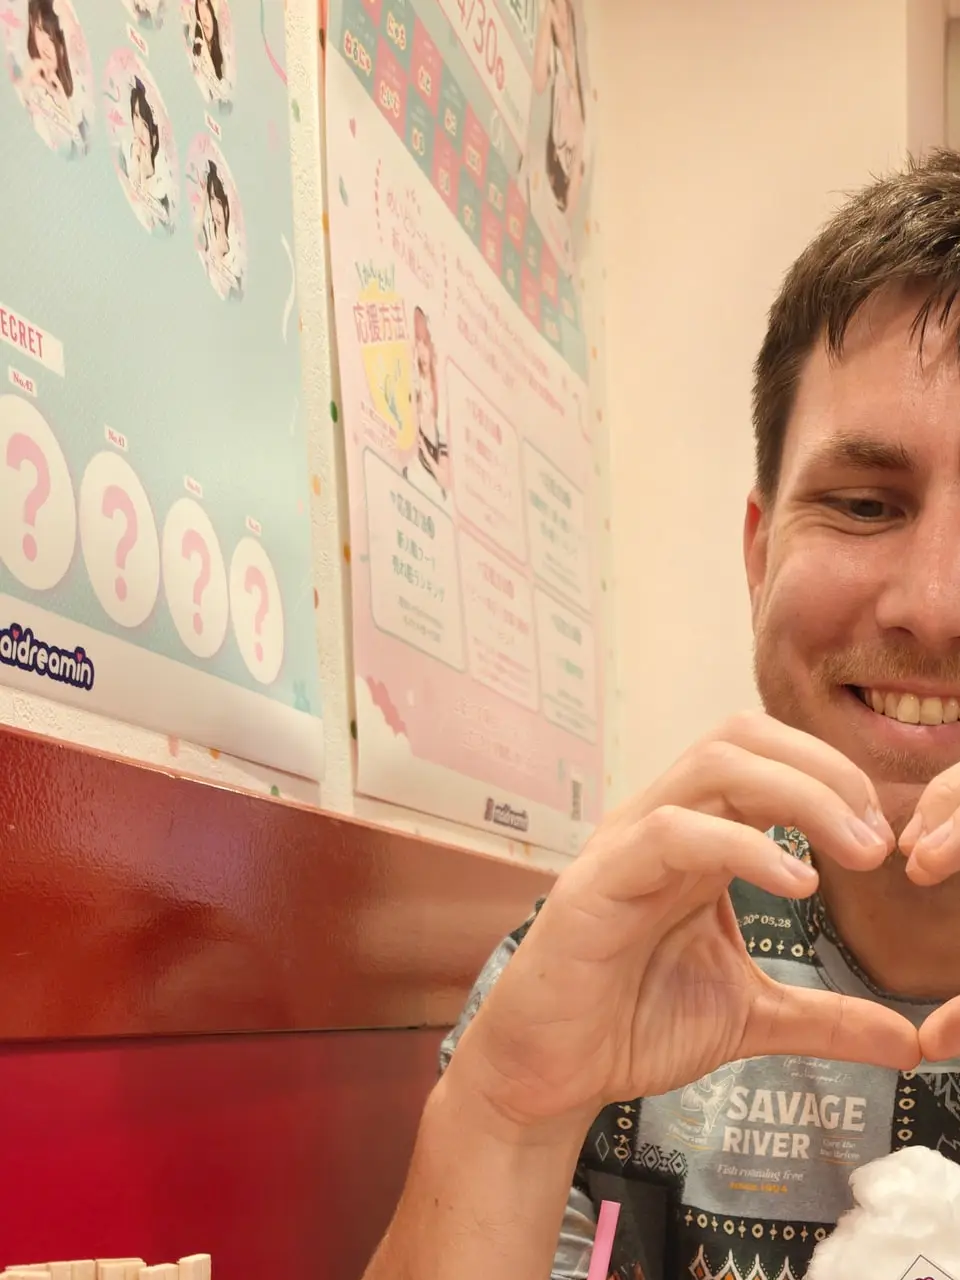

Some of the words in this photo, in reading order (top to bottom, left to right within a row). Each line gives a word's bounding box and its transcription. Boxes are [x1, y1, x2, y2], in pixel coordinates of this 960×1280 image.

[0, 308, 43, 360] ECRET
[727, 1085, 867, 1132] SAVAGE
[722, 1125, 811, 1160] RIVER
[717, 1163, 739, 1175] Fish
[782, 1170, 804, 1181] free
